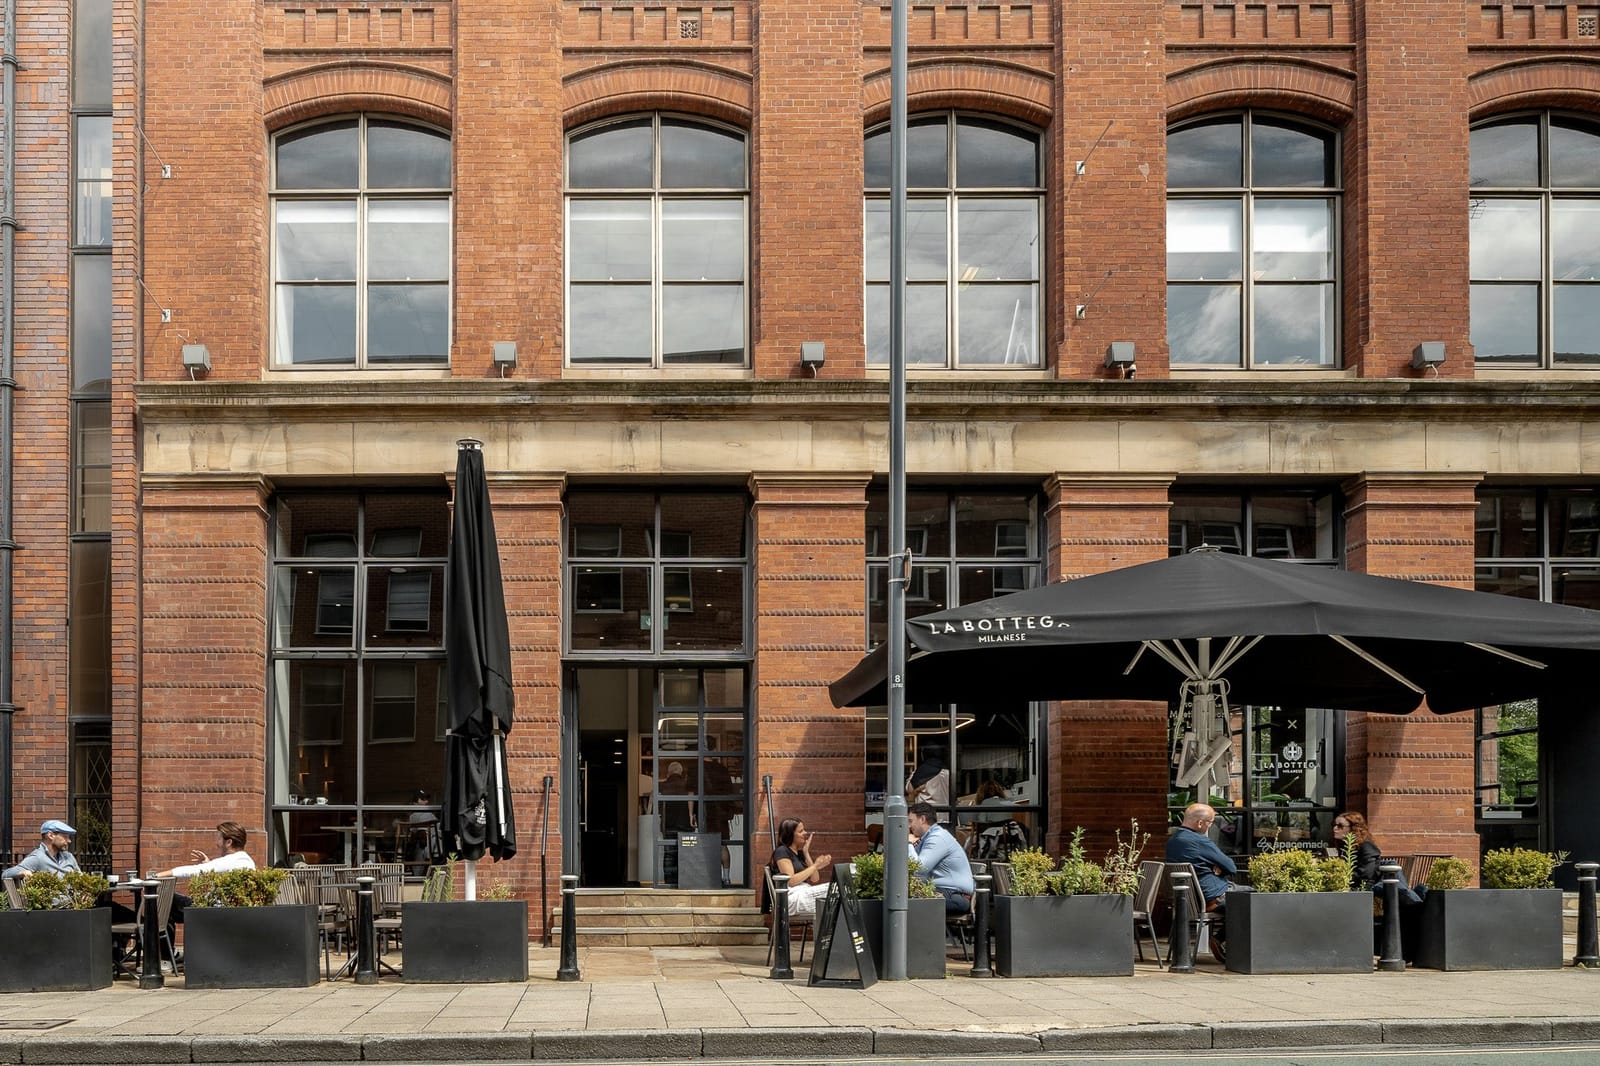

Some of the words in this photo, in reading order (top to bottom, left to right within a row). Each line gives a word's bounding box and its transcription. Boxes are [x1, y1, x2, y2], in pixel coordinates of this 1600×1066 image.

[930, 622, 956, 635] LA
[979, 633, 1026, 643] MILANESE
[895, 674, 901, 683] 8
